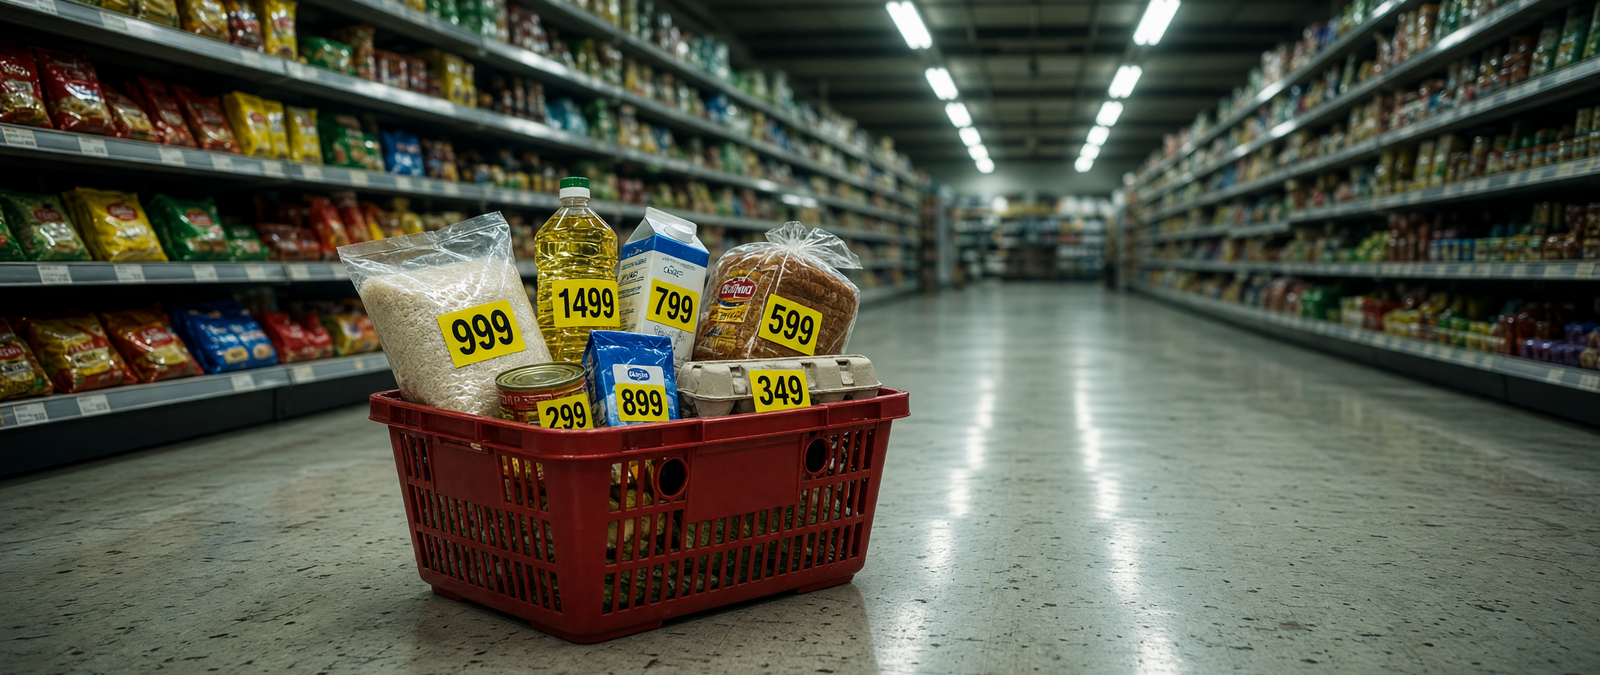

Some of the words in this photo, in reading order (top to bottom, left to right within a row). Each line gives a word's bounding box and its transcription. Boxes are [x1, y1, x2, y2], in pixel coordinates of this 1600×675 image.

[558, 288, 615, 319] 1499
[656, 286, 693, 324] 799
[451, 310, 514, 355] 999
[768, 304, 814, 345] 599
[622, 389, 662, 416] 899
[758, 376, 803, 406] 349
[546, 402, 587, 429] 299
